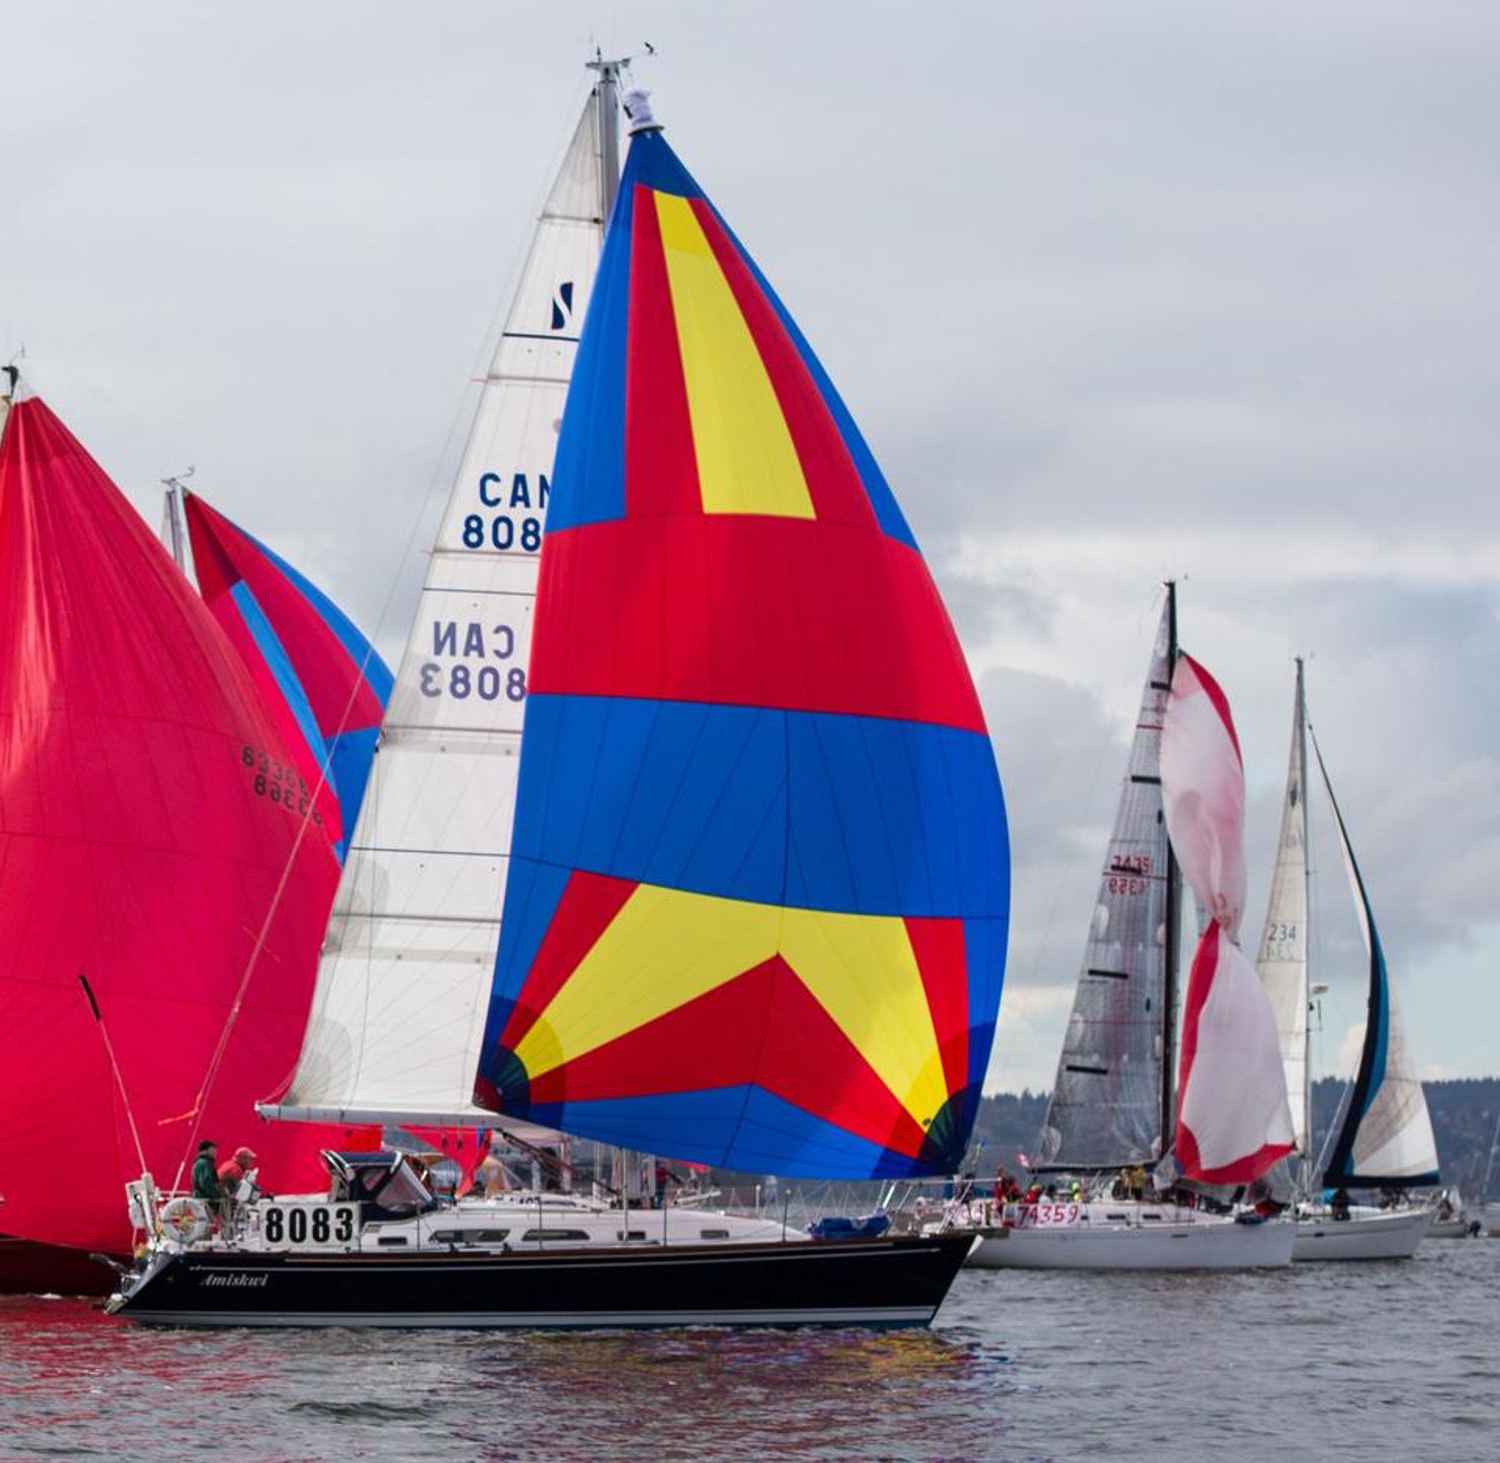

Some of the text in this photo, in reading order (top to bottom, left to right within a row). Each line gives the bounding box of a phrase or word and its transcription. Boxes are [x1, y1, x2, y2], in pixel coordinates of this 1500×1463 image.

[1268, 923, 1297, 942] 234
[265, 1207, 354, 1244] 8083
[1016, 1205, 1080, 1228] 74359
